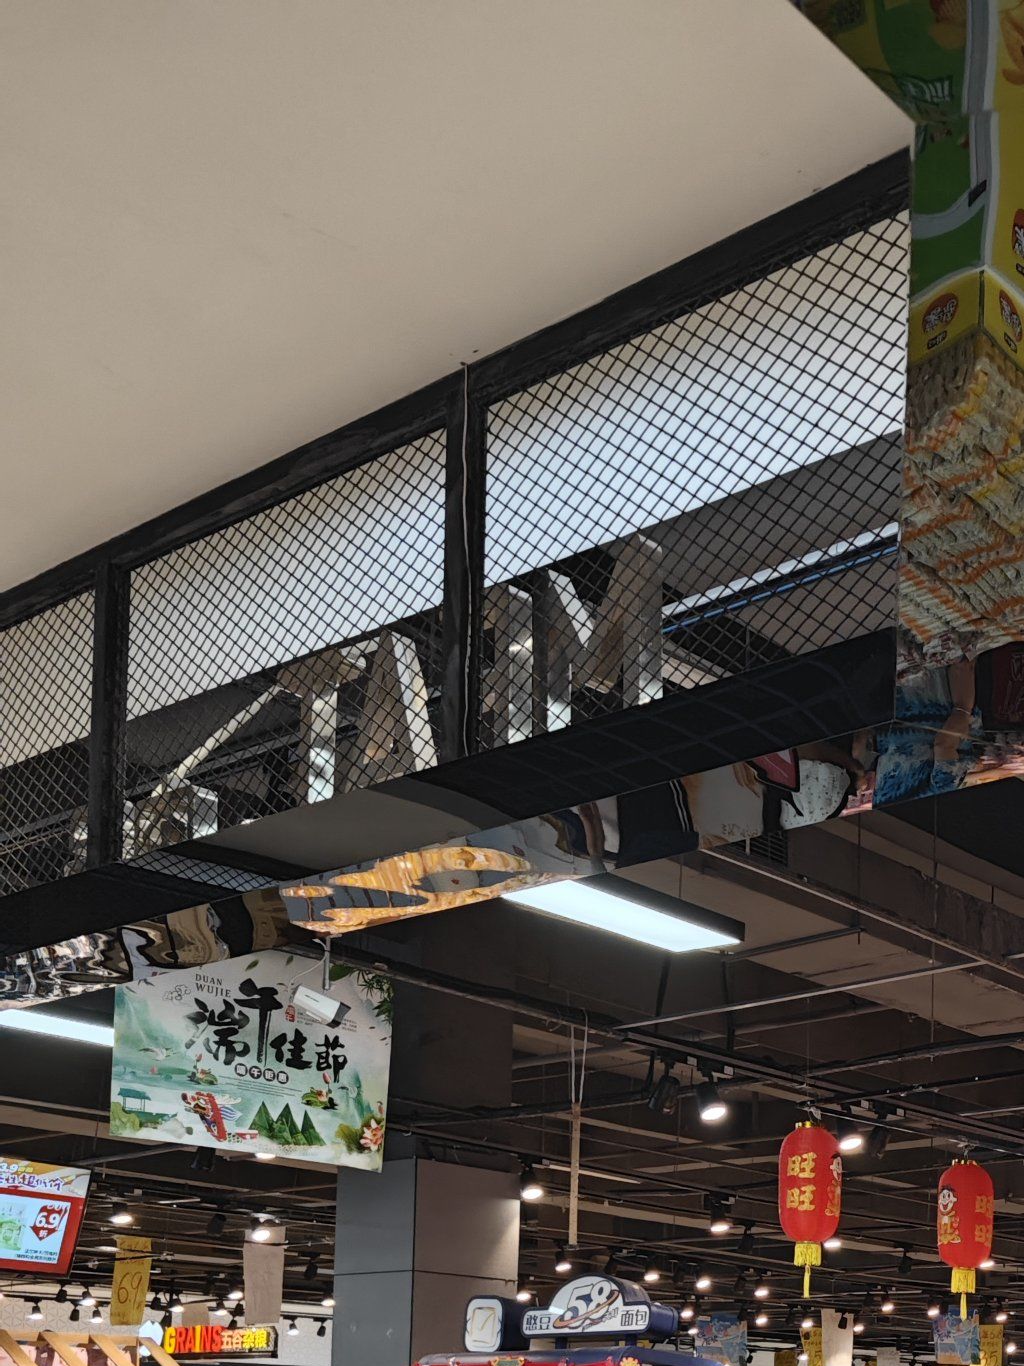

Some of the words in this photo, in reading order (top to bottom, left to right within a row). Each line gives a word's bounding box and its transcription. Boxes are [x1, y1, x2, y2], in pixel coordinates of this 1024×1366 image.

[195, 973, 223, 987] DUAN
[195, 983, 232, 998] WUJIE
[786, 1152, 816, 1212] 旺旺
[36, 1212, 61, 1228] 6.9
[620, 1309, 648, 1326] 面包
[164, 1326, 222, 1354] GRAINS
